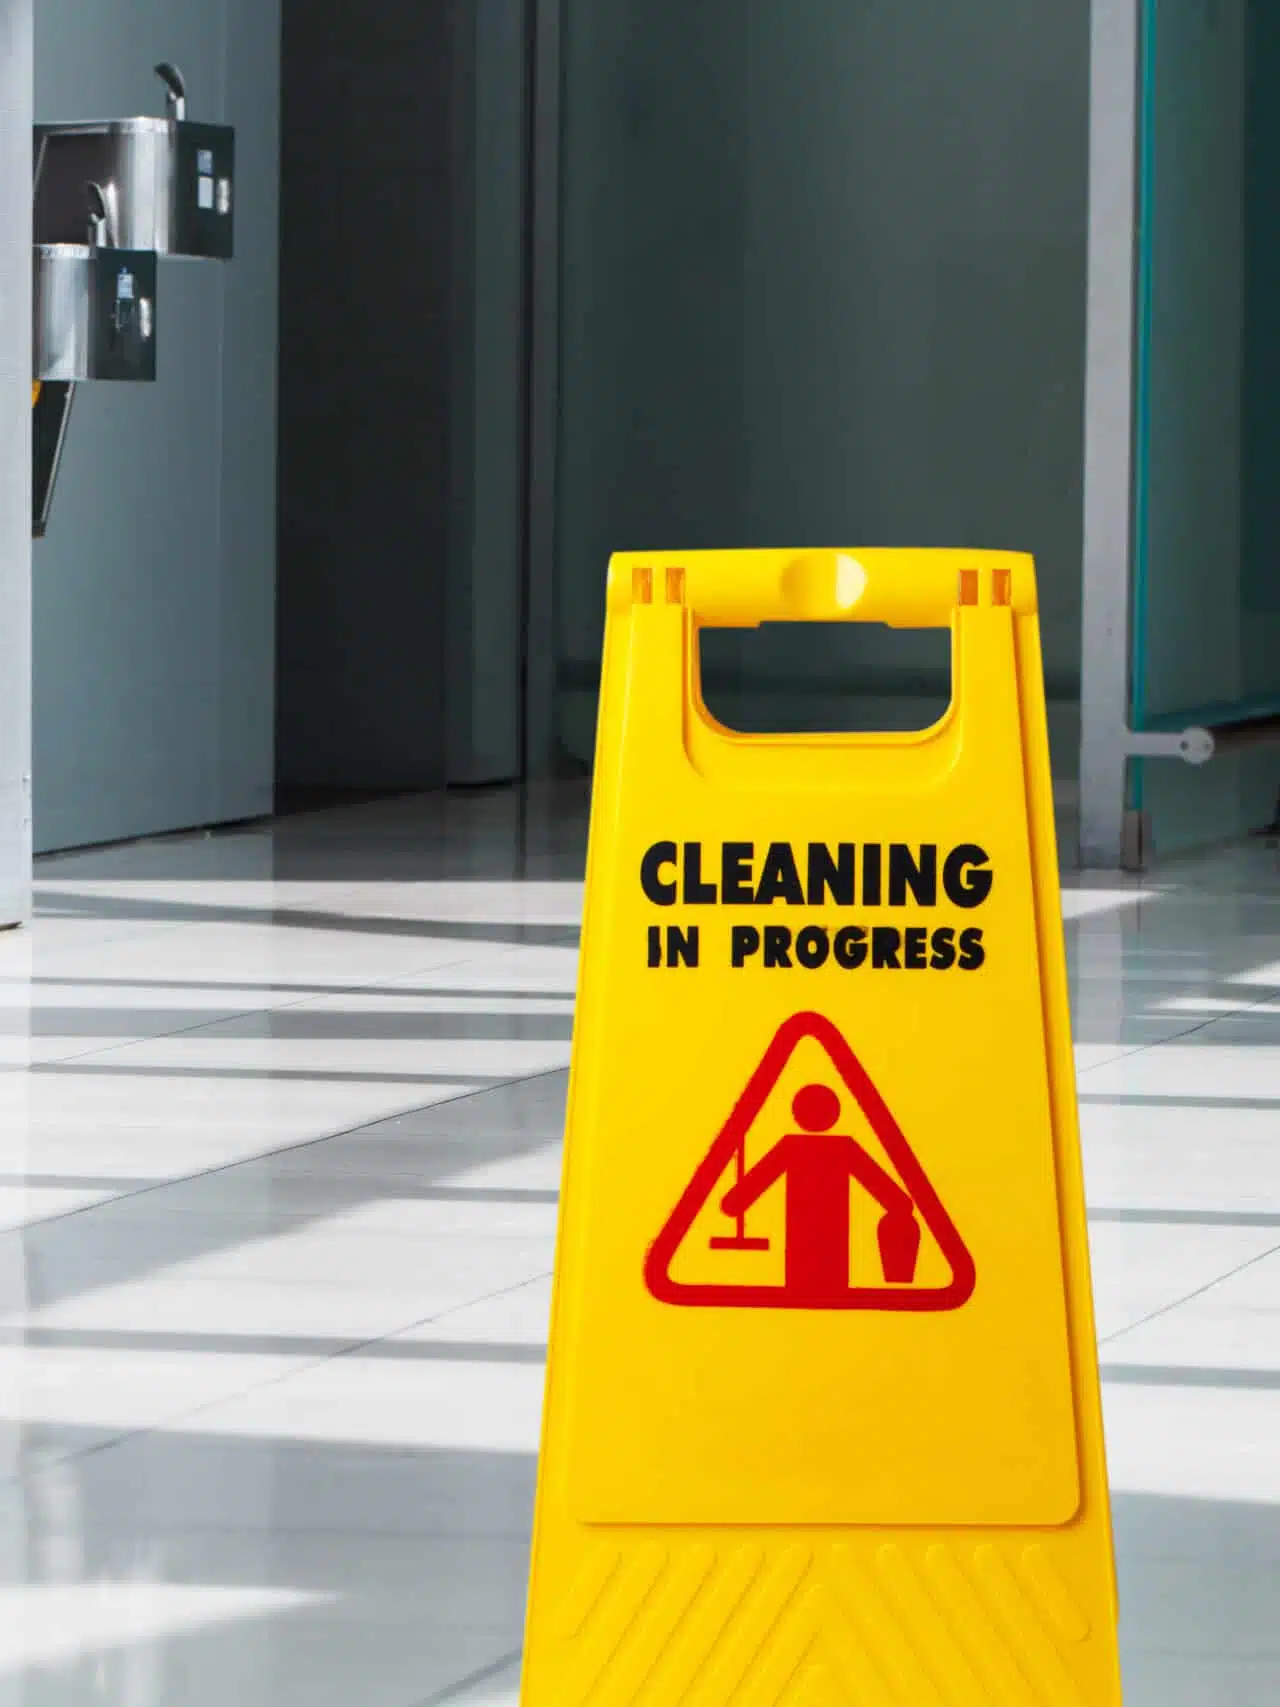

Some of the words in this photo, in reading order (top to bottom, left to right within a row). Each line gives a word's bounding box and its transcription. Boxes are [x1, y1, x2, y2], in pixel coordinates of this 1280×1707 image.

[639, 840, 993, 908] CLEANING
[647, 925, 700, 968] IN
[731, 925, 985, 970] PROGRESS
